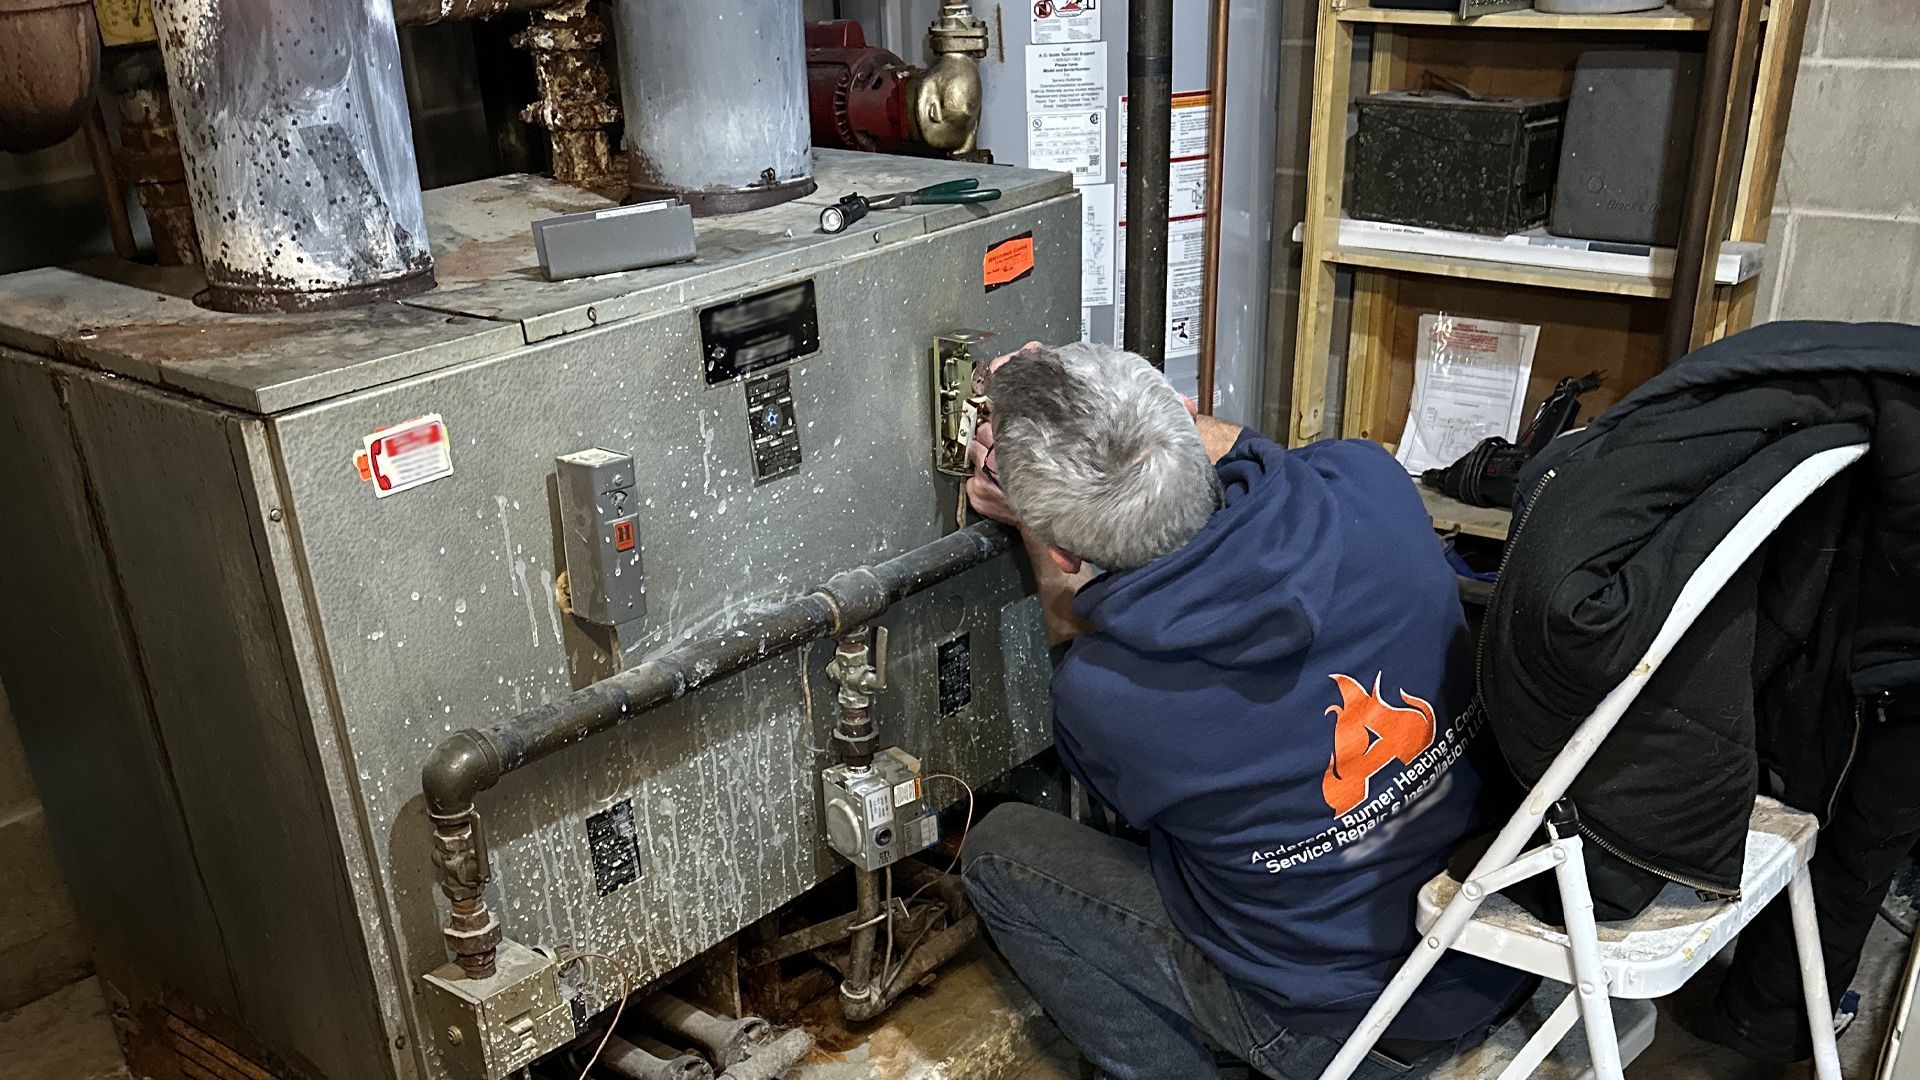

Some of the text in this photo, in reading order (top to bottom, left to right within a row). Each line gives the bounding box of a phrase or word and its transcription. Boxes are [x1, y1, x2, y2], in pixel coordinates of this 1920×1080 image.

[1266, 842, 1333, 874] Service
[1336, 812, 1388, 847] Repair
[1404, 737, 1469, 807] Installation
[1341, 786, 1396, 829] Burner
[1392, 740, 1448, 790] Heating
[1445, 728, 1455, 744] &
[1455, 692, 1482, 732] Cooli
